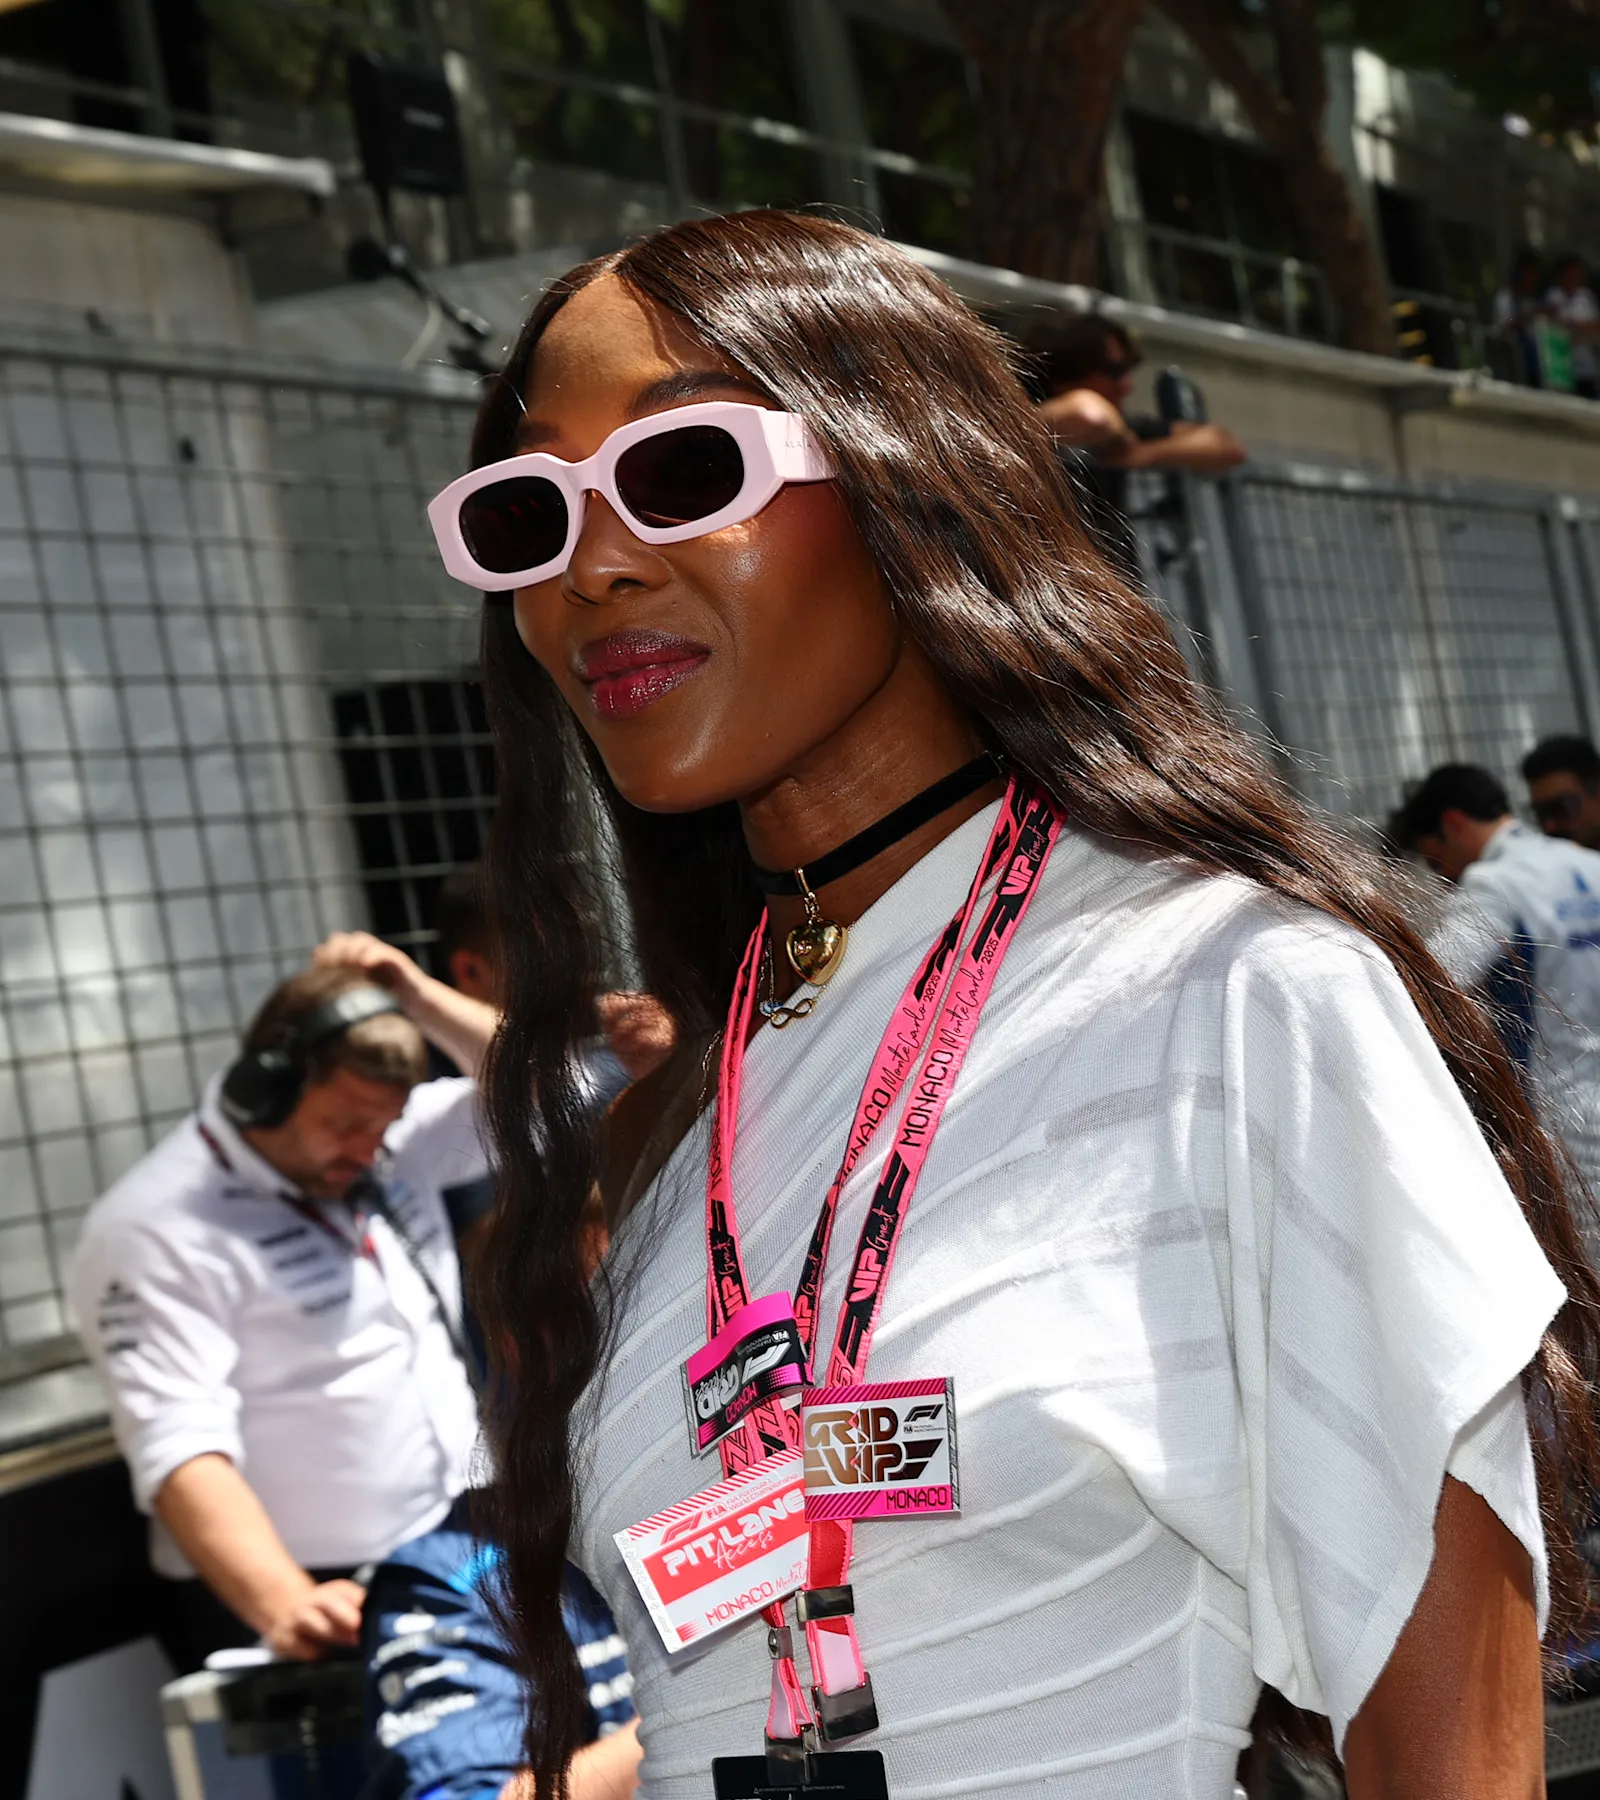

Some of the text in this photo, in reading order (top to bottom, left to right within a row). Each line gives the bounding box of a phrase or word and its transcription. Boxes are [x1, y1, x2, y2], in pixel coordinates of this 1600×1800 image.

[1000, 824, 1047, 895] VIP Guest
[881, 1045, 911, 1093] Monte
[897, 1003, 926, 1050] Carlo
[923, 974, 941, 1003] 2025
[898, 937, 999, 1147] MONACO Monte Carlo 2025
[849, 1206, 897, 1302] VIP Guest
[697, 1364, 740, 1419] GRID
[804, 1407, 899, 1448] GRID
[822, 1442, 903, 1485] VIP
[706, 1505, 727, 1520] FIA
[886, 1487, 947, 1509] MONACO
[662, 1532, 716, 1577] PIT
[714, 1529, 774, 1570] Access
[705, 1581, 774, 1625] MONACO
